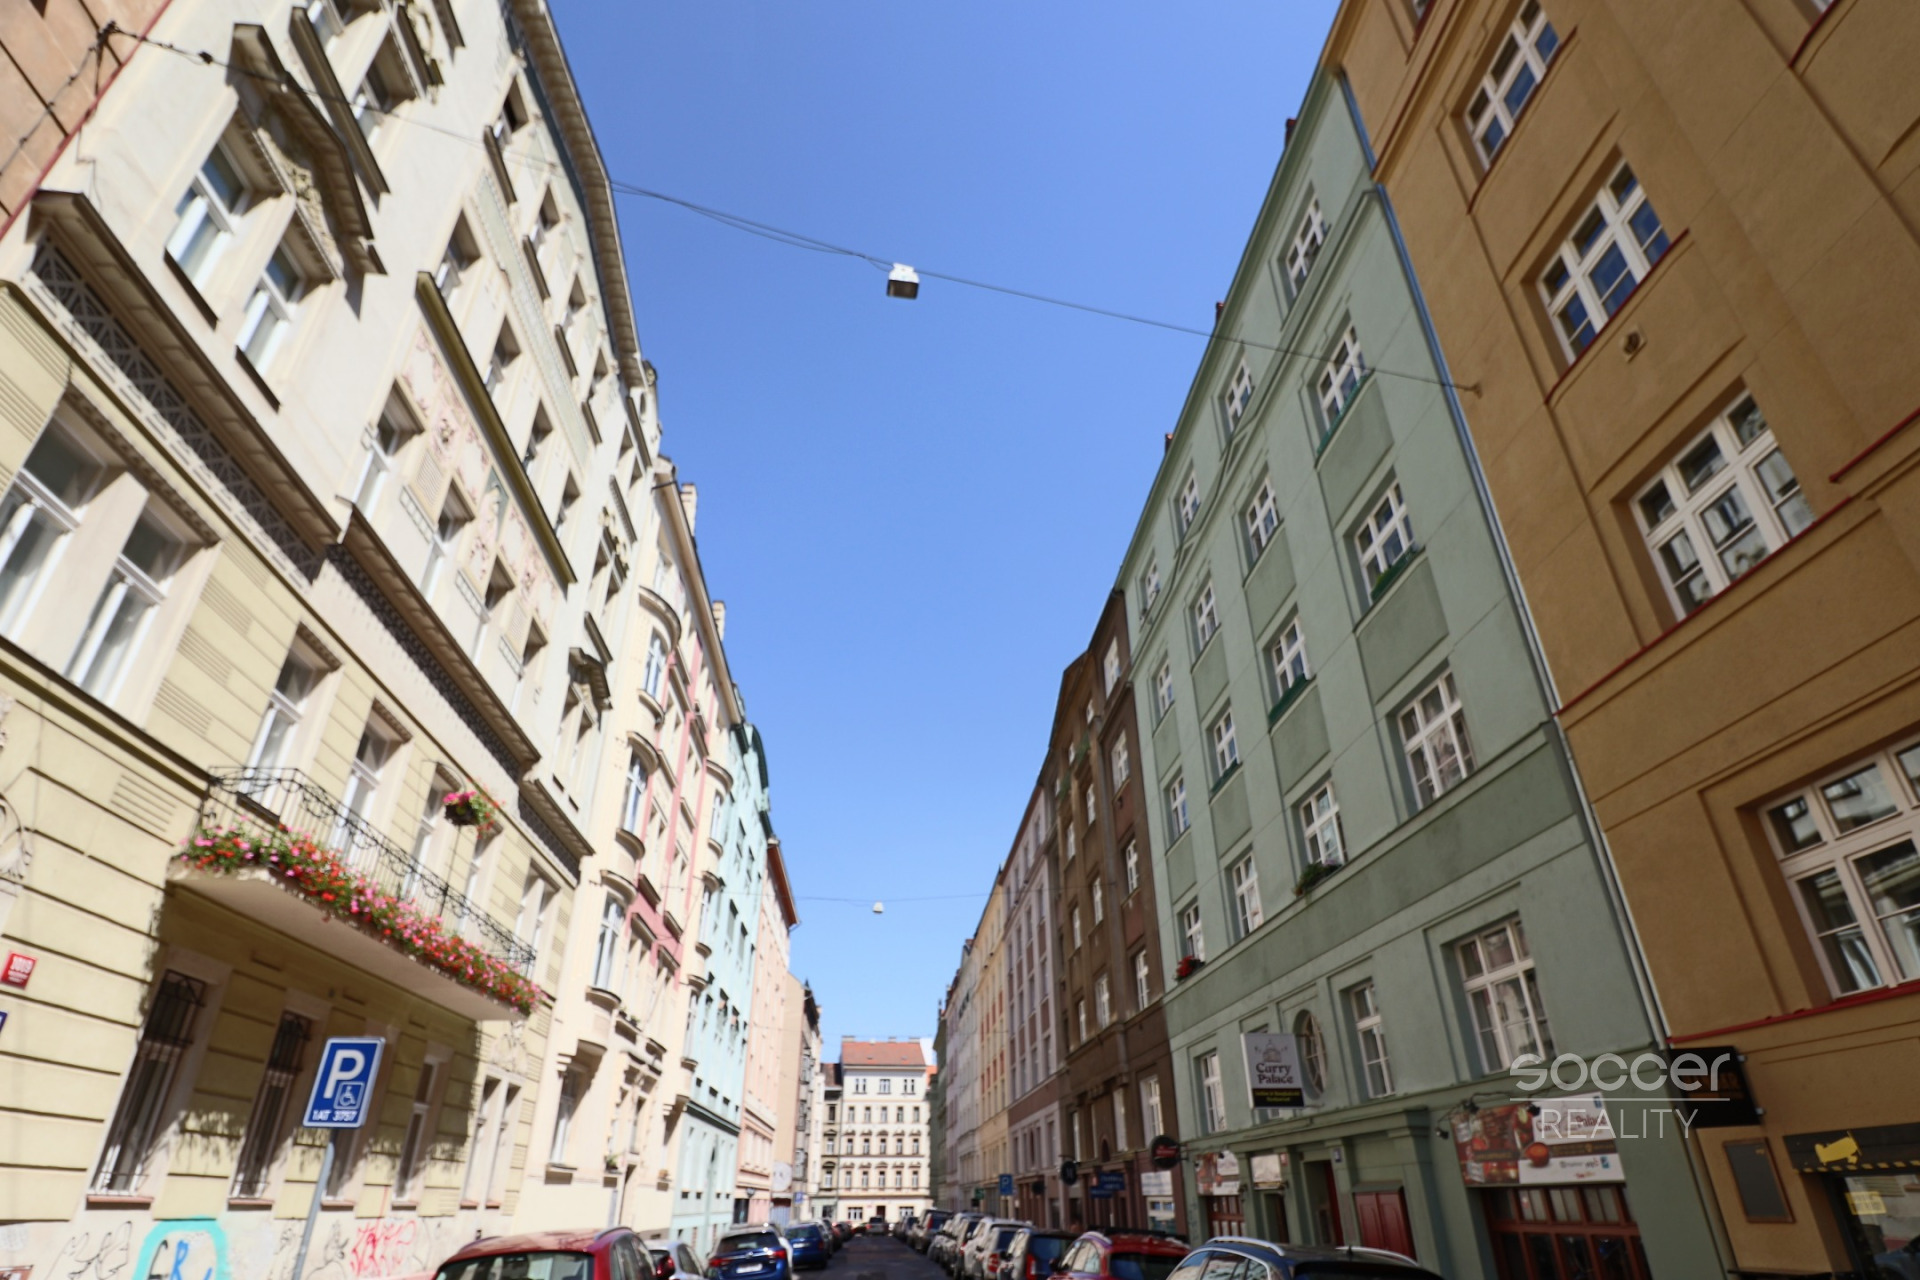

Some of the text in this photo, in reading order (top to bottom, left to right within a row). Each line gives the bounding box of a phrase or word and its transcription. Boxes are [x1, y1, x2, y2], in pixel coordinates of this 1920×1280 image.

[323, 1049, 366, 1099] P
[1256, 1063, 1291, 1076] Curry
[1257, 1073, 1294, 1084] Palace
